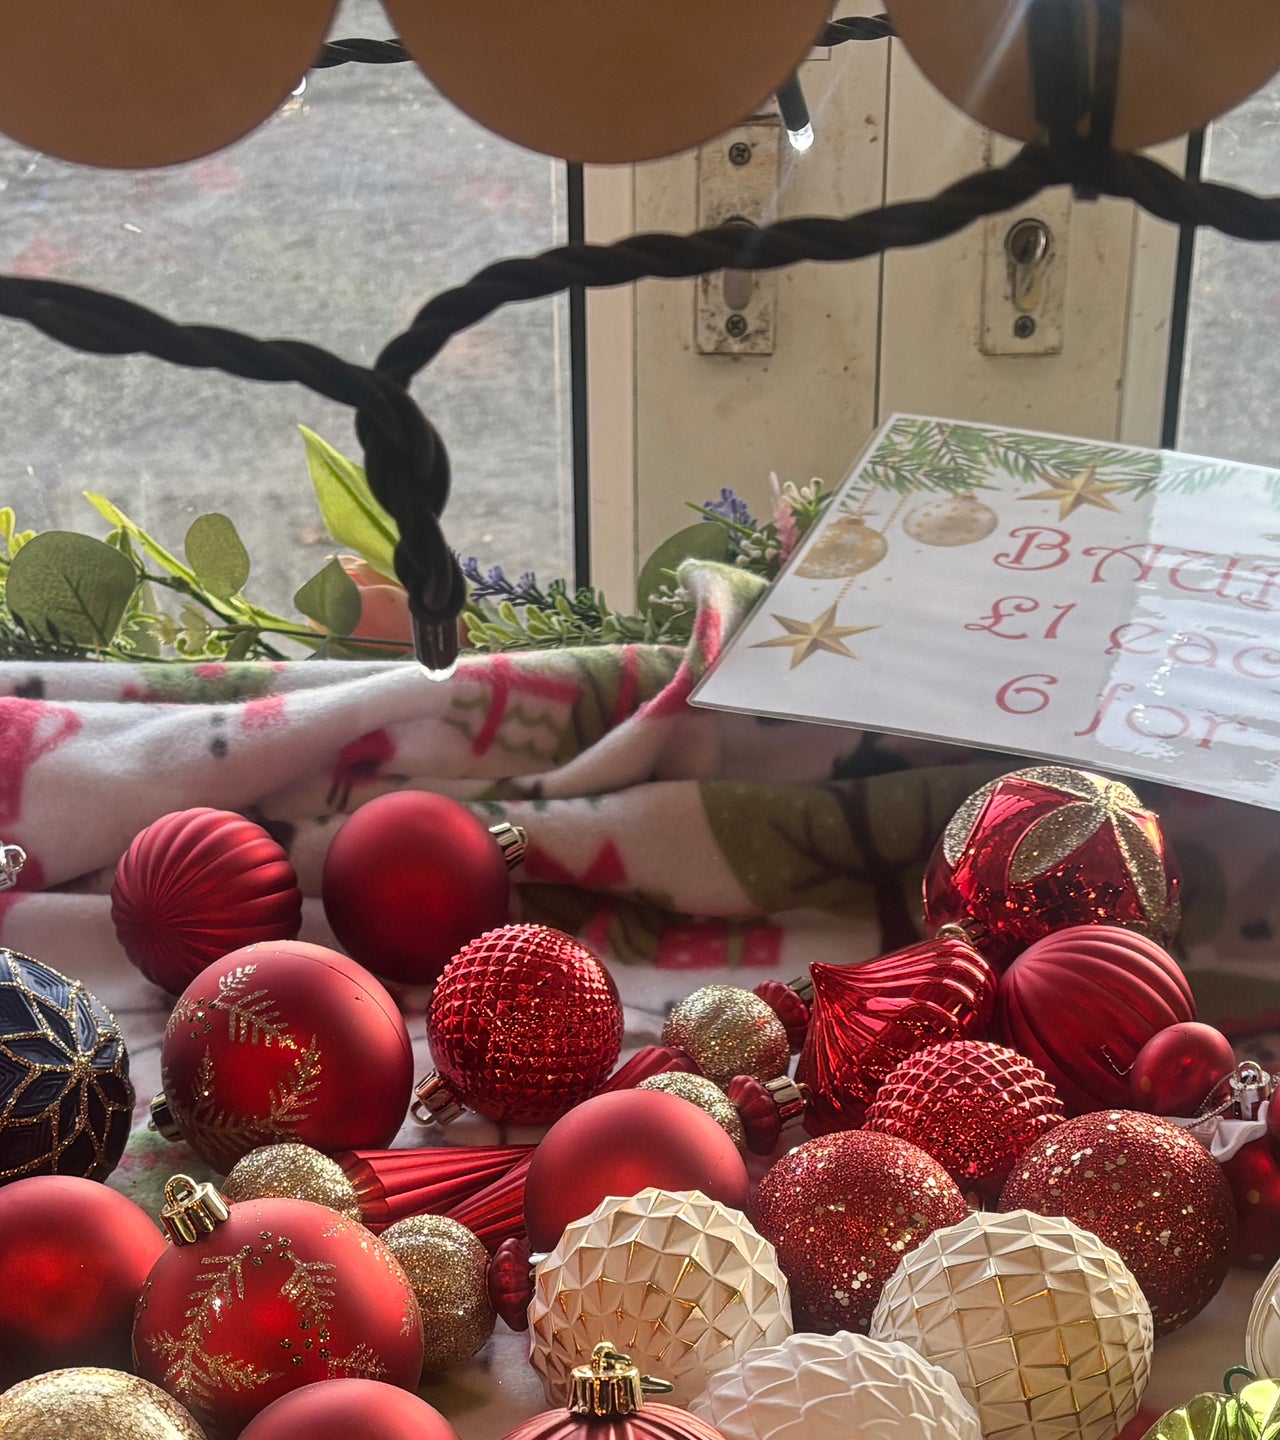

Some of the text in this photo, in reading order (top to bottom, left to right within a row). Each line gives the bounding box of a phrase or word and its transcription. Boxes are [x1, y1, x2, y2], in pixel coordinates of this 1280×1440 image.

[965, 595, 1077, 641] £1
[994, 673, 1059, 715] 6
[1073, 682, 1249, 749] for
